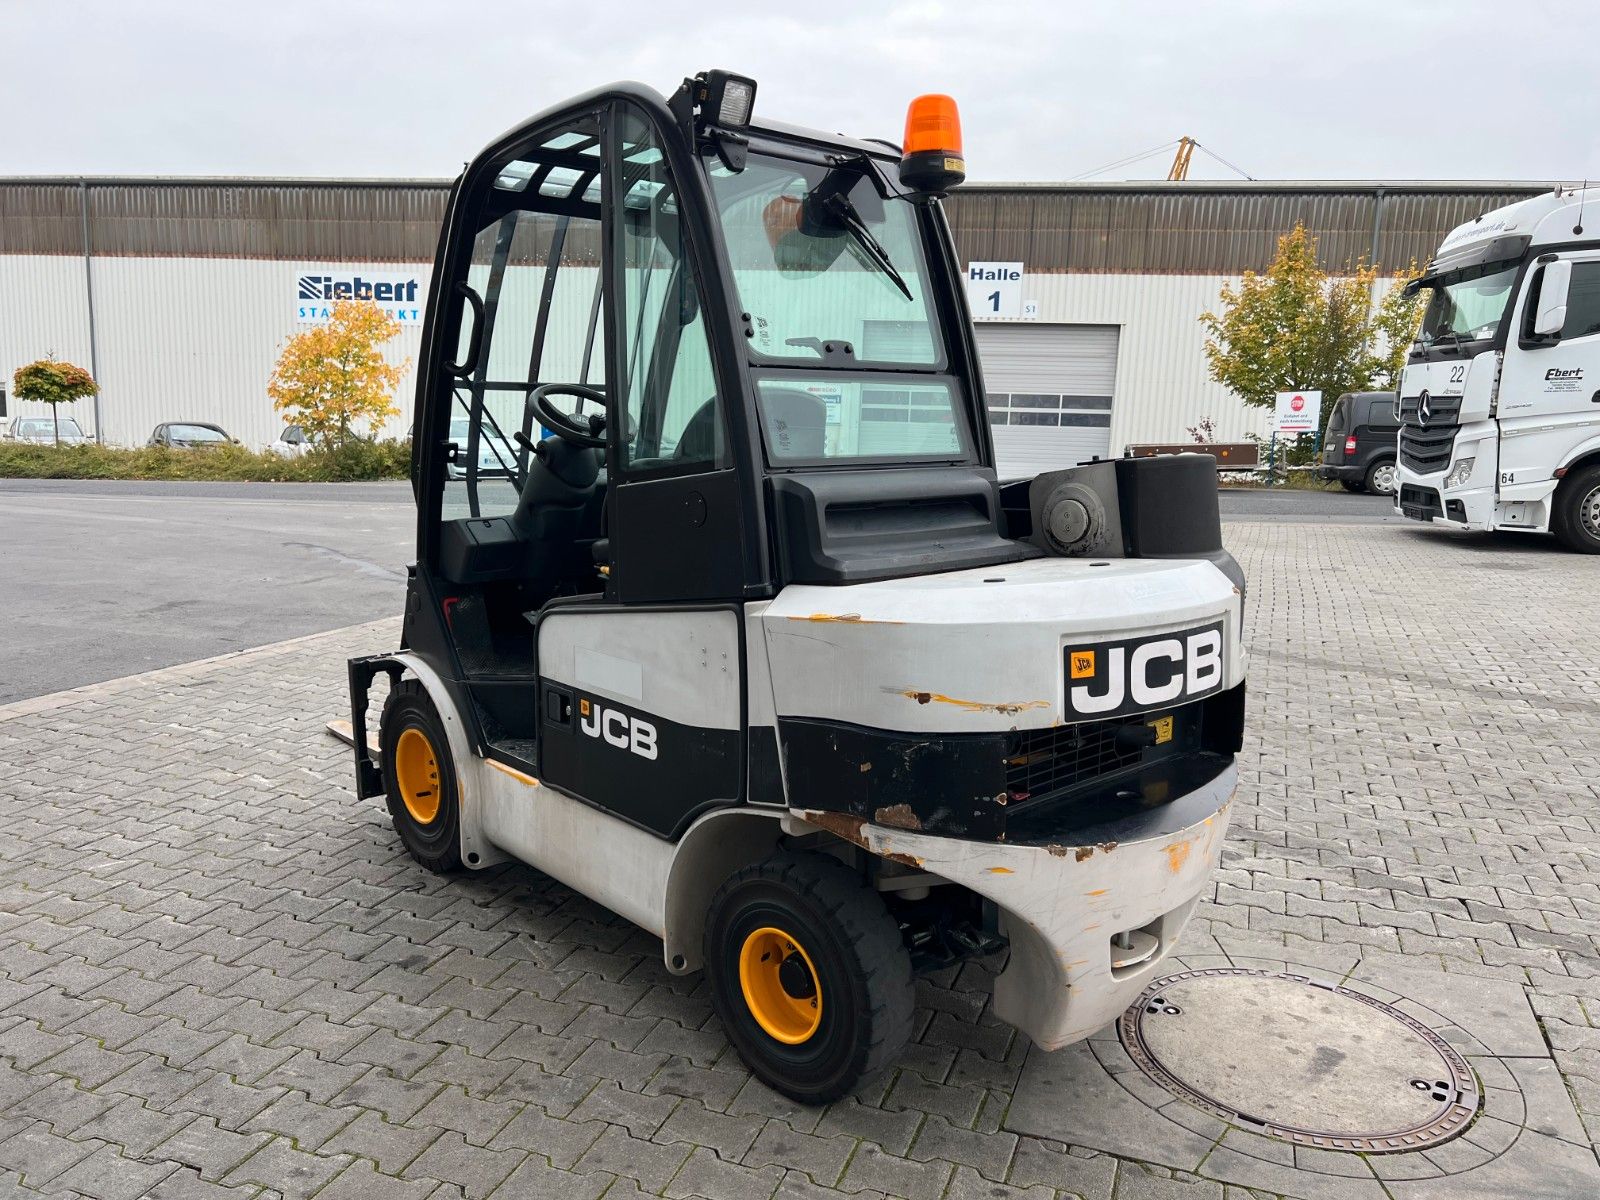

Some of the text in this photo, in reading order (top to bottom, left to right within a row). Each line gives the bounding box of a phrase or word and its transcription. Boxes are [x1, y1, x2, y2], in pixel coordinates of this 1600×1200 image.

[970, 268, 1020, 280] Halle
[298, 277, 418, 301] Siebert
[988, 290, 1000, 311] 1
[1450, 365, 1465, 383] 22
[1545, 368, 1583, 380] Ebert
[1291, 399, 1304, 408] STOP
[1501, 473, 1514, 483] 64
[1071, 630, 1221, 713] JCB
[581, 704, 658, 760] JCB
